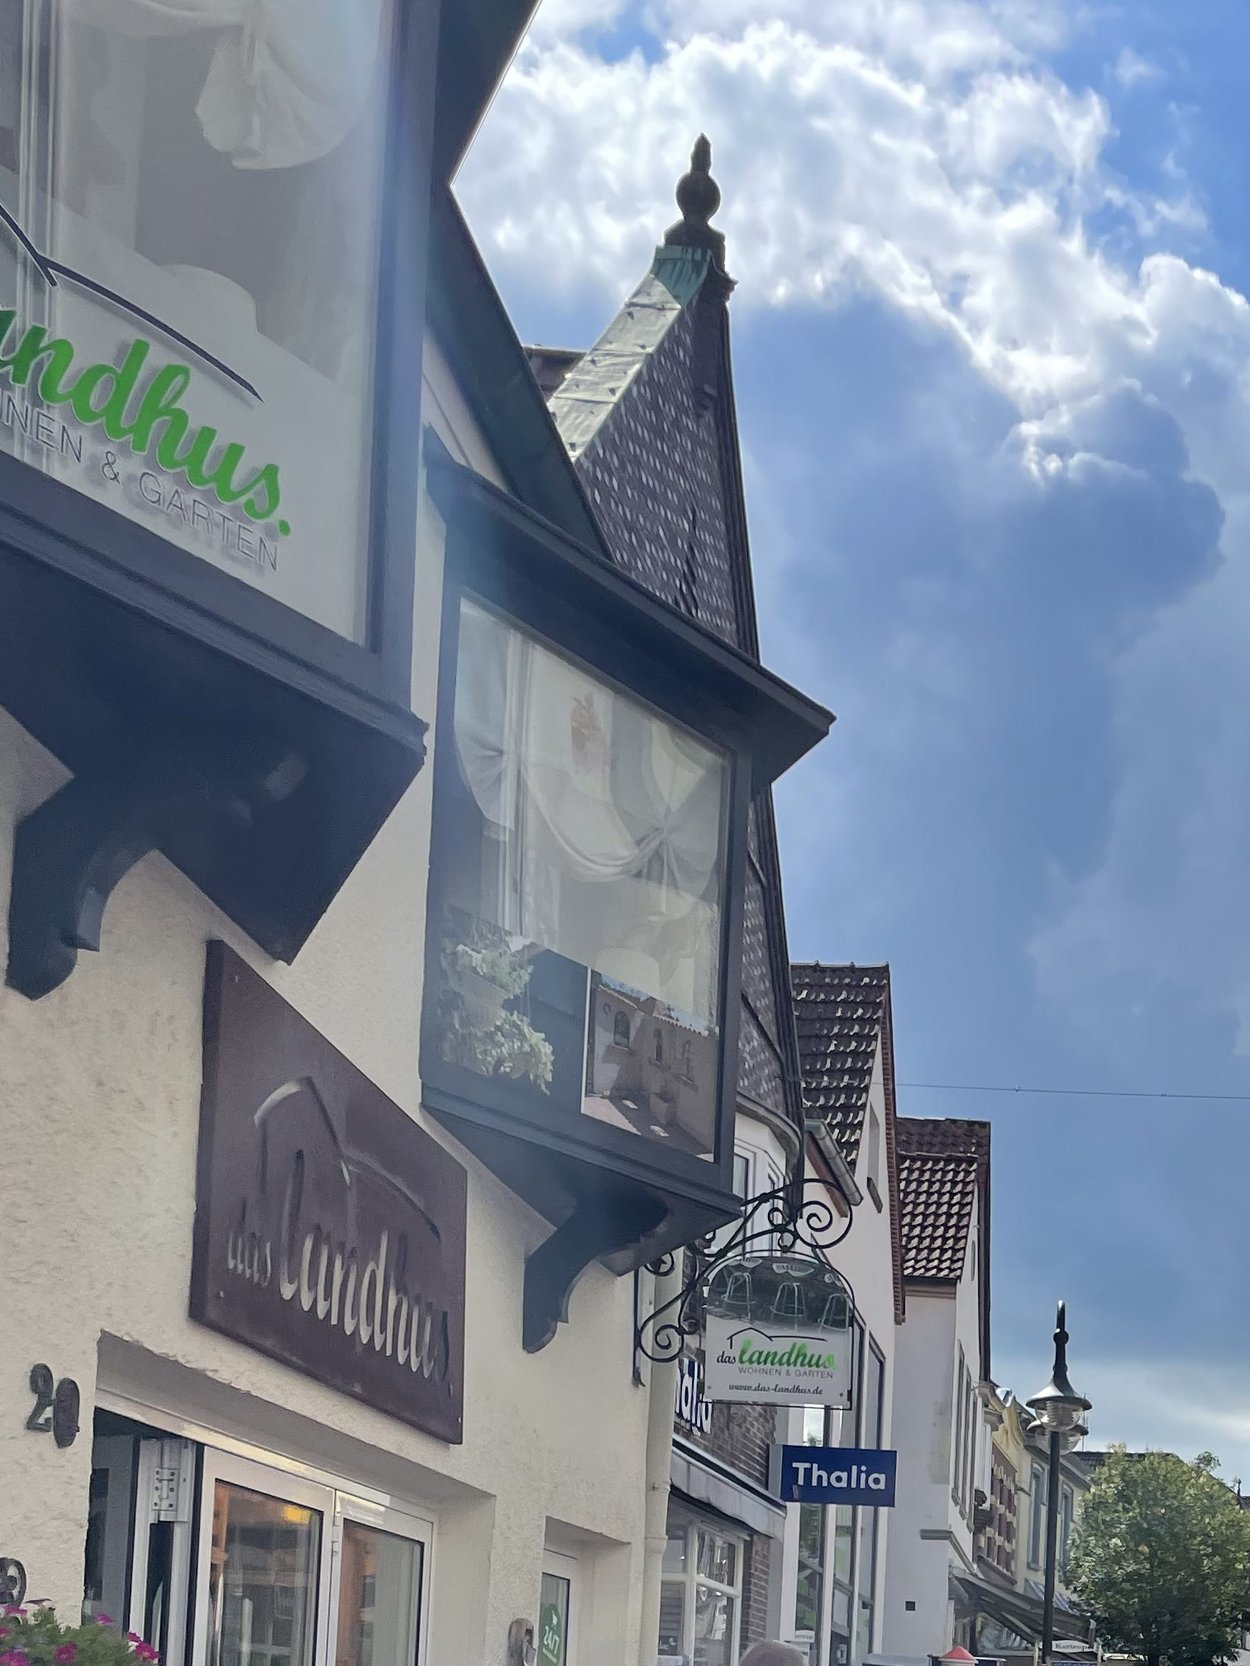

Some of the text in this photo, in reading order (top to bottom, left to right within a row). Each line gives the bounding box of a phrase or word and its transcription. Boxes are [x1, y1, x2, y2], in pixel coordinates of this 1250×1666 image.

[101, 450, 121, 486] &
[138, 471, 278, 573] GARTEN
[716, 1350, 736, 1364] das
[738, 1366, 834, 1379] WOHNEN & GARTEN
[728, 1383, 823, 1395] www.das-landhus.de
[792, 1461, 886, 1490] Thalia
